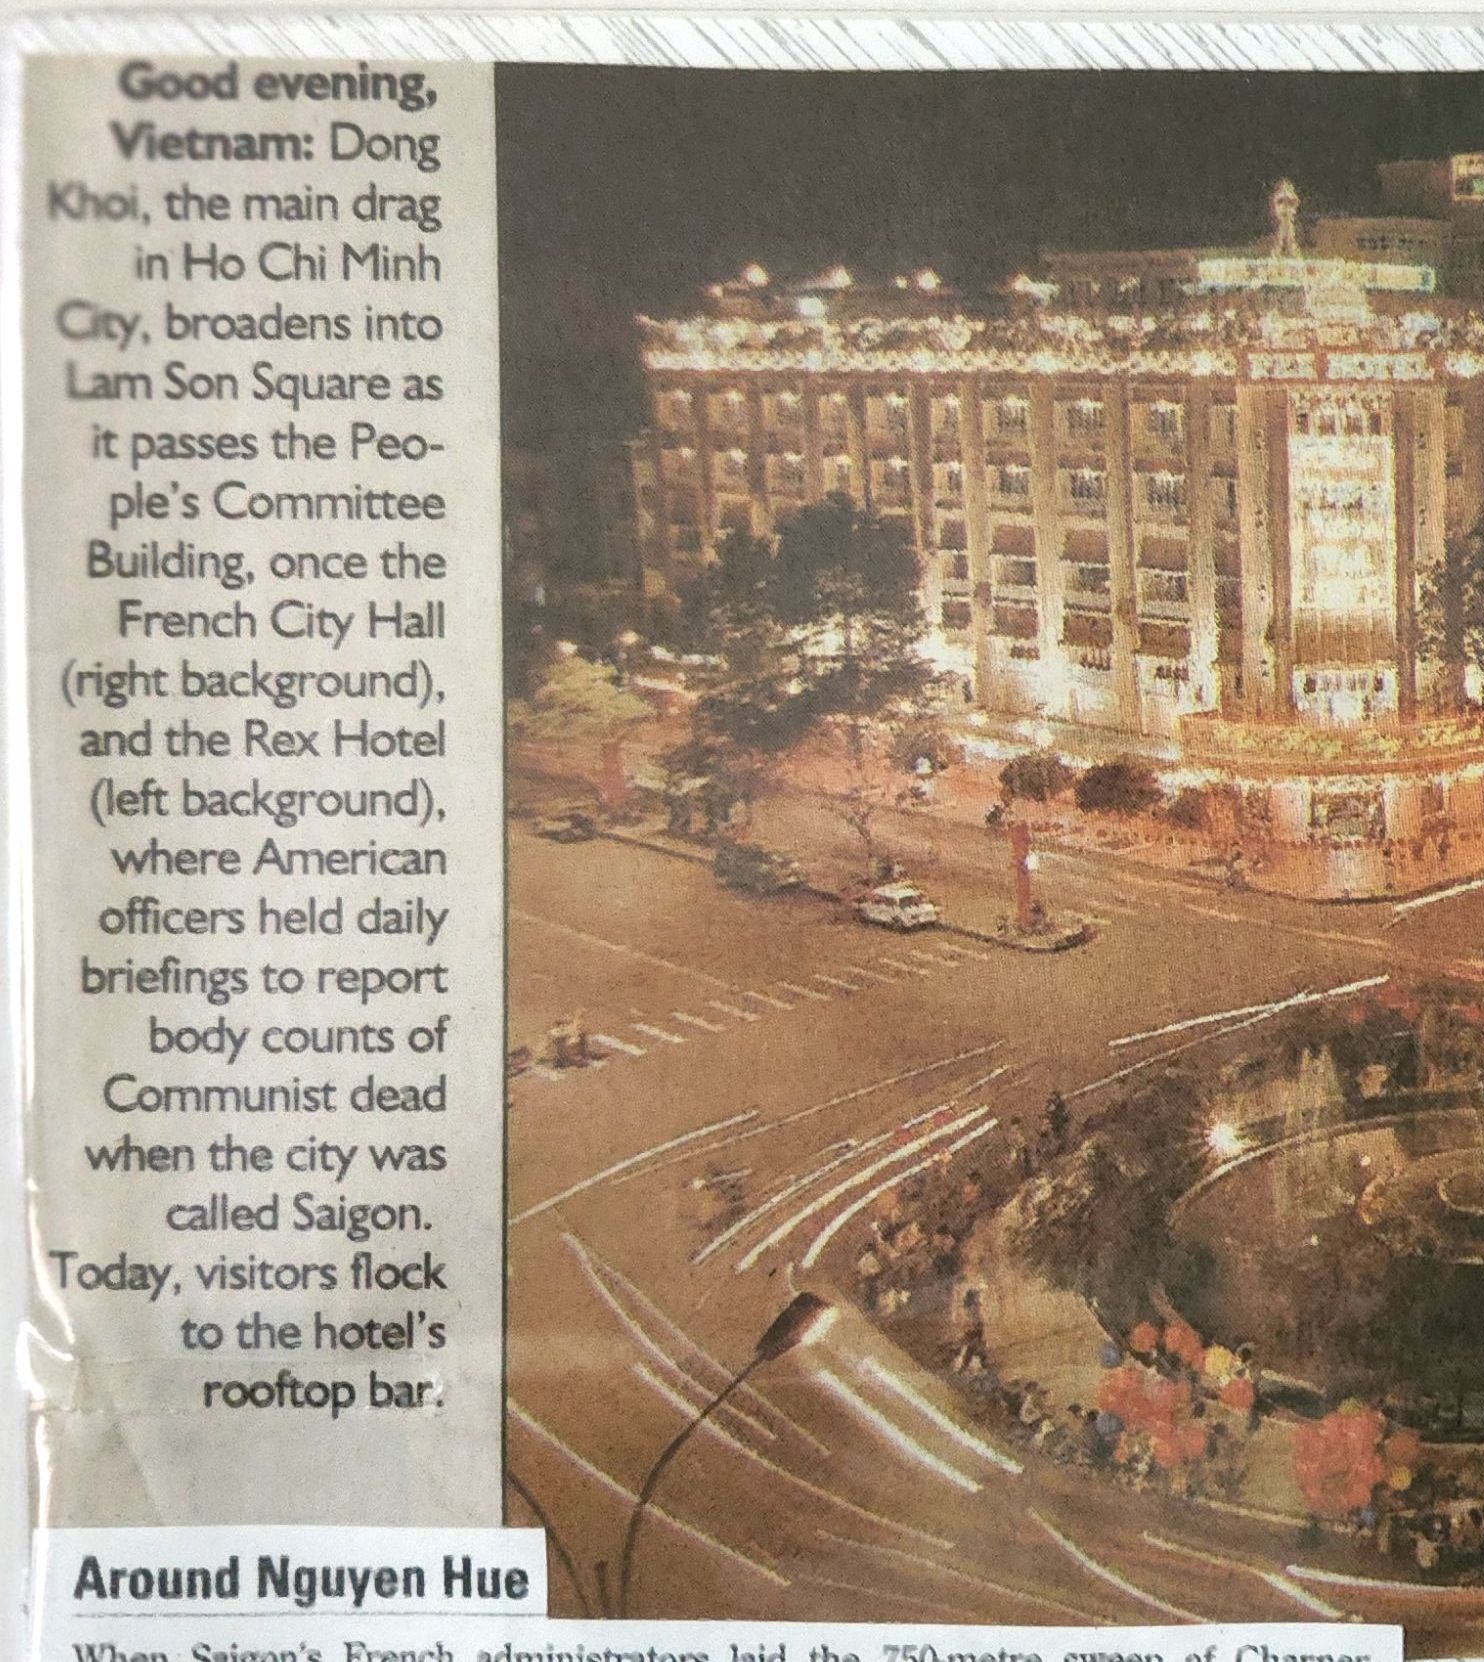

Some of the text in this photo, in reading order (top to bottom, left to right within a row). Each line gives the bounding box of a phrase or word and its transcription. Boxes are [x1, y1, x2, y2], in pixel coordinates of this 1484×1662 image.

[116, 58, 438, 114] Good evening,
[108, 119, 442, 174] Vietnam: Dong
[47, 181, 443, 234] Khoi, the main drag
[133, 240, 442, 283] in Ho Chi Minh
[54, 298, 444, 352] City, broadens into
[65, 359, 445, 412] Lam Son Square as
[91, 420, 446, 472] it passes the Peo-
[108, 479, 447, 532] ple's Committee
[86, 538, 448, 591] Building, once the
[117, 598, 446, 651] French City Hall
[60, 658, 446, 710] (right background),
[78, 717, 446, 758] and the Rex Hotel
[89, 777, 447, 829] (left background),
[109, 836, 448, 877] where American
[97, 895, 450, 947] officers held daily
[80, 954, 450, 1007] briefings to report
[148, 1013, 452, 1066] body counts of
[102, 1072, 447, 1114] Communist dead
[83, 1132, 448, 1184] when the city was
[165, 1191, 433, 1243] called Saigon.
[46, 1249, 449, 1303] Today, visitors flock
[179, 1309, 447, 1352] to the hotel's
[202, 1368, 445, 1421] rooftop bar.
[72, 1553, 530, 1610] Around Nguyen Hue
